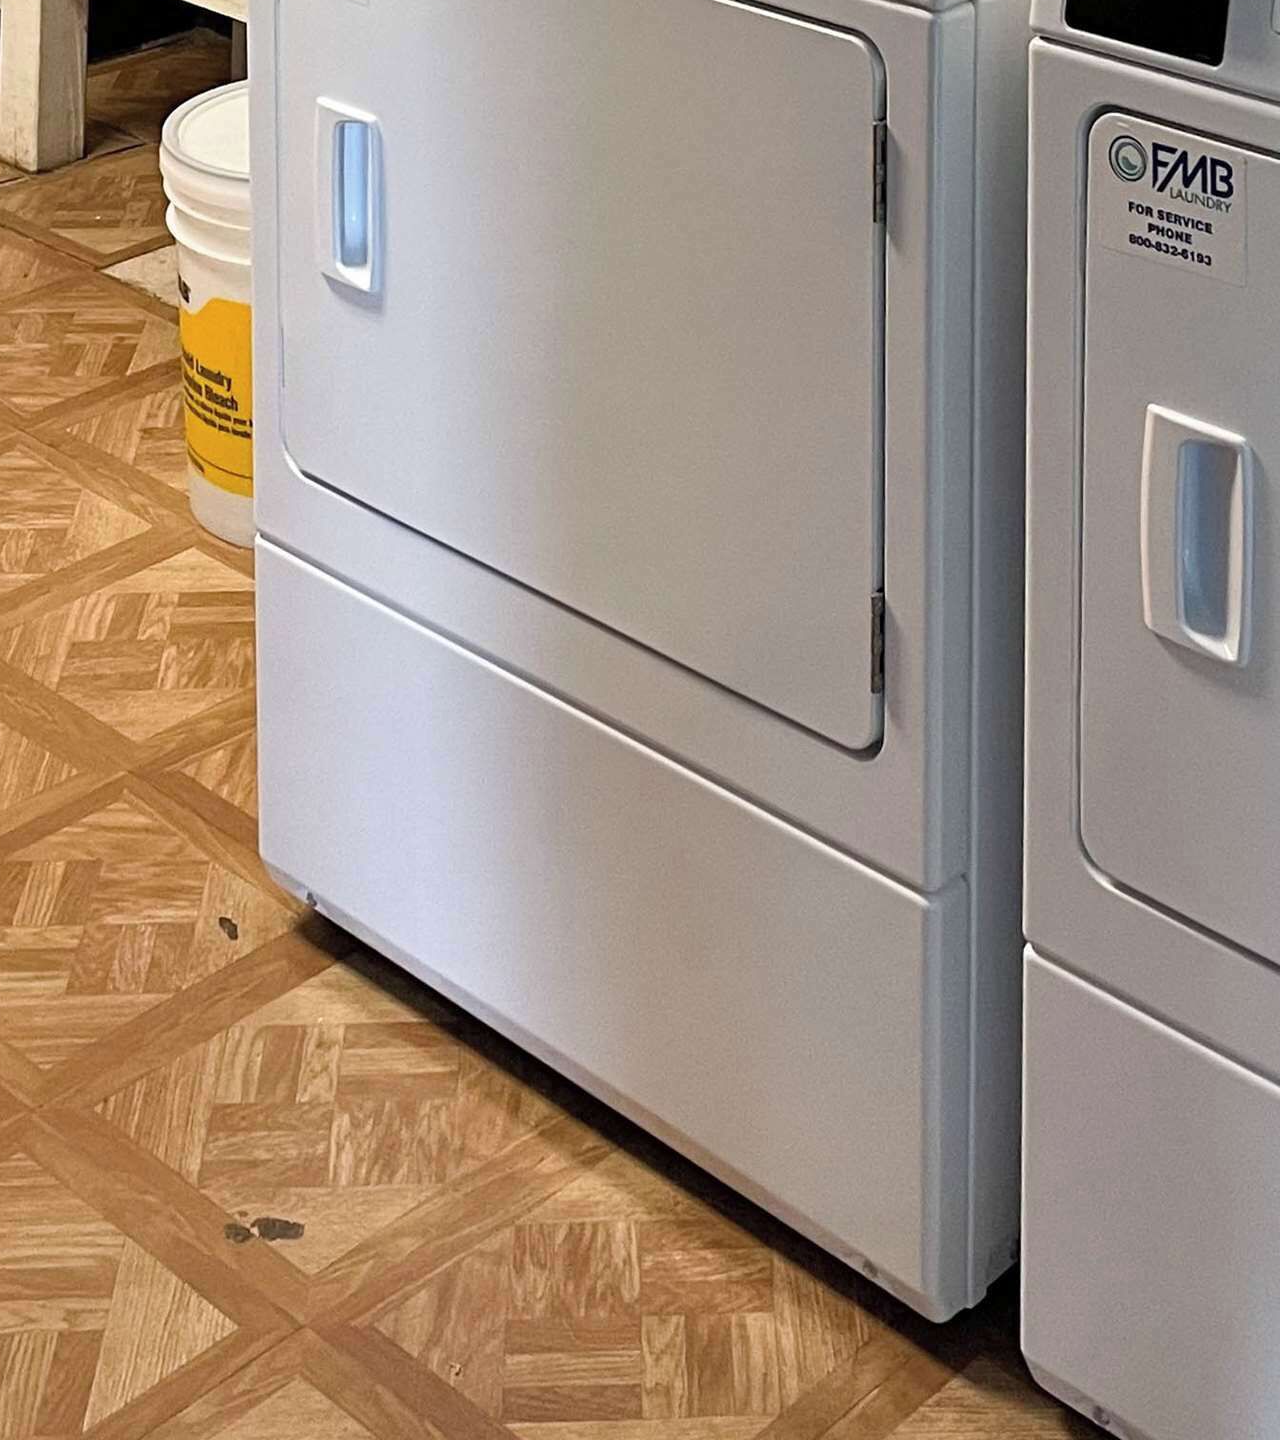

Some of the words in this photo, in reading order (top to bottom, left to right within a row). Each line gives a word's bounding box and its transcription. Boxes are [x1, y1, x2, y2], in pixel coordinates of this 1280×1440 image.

[1151, 141, 1234, 199] FMB
[1170, 187, 1232, 214] LAUNDRY
[1128, 201, 1153, 218] FOR
[1157, 210, 1213, 235] SERVICE
[1147, 222, 1193, 245] PHONE
[1129, 233, 1212, 267] 800-832-6193
